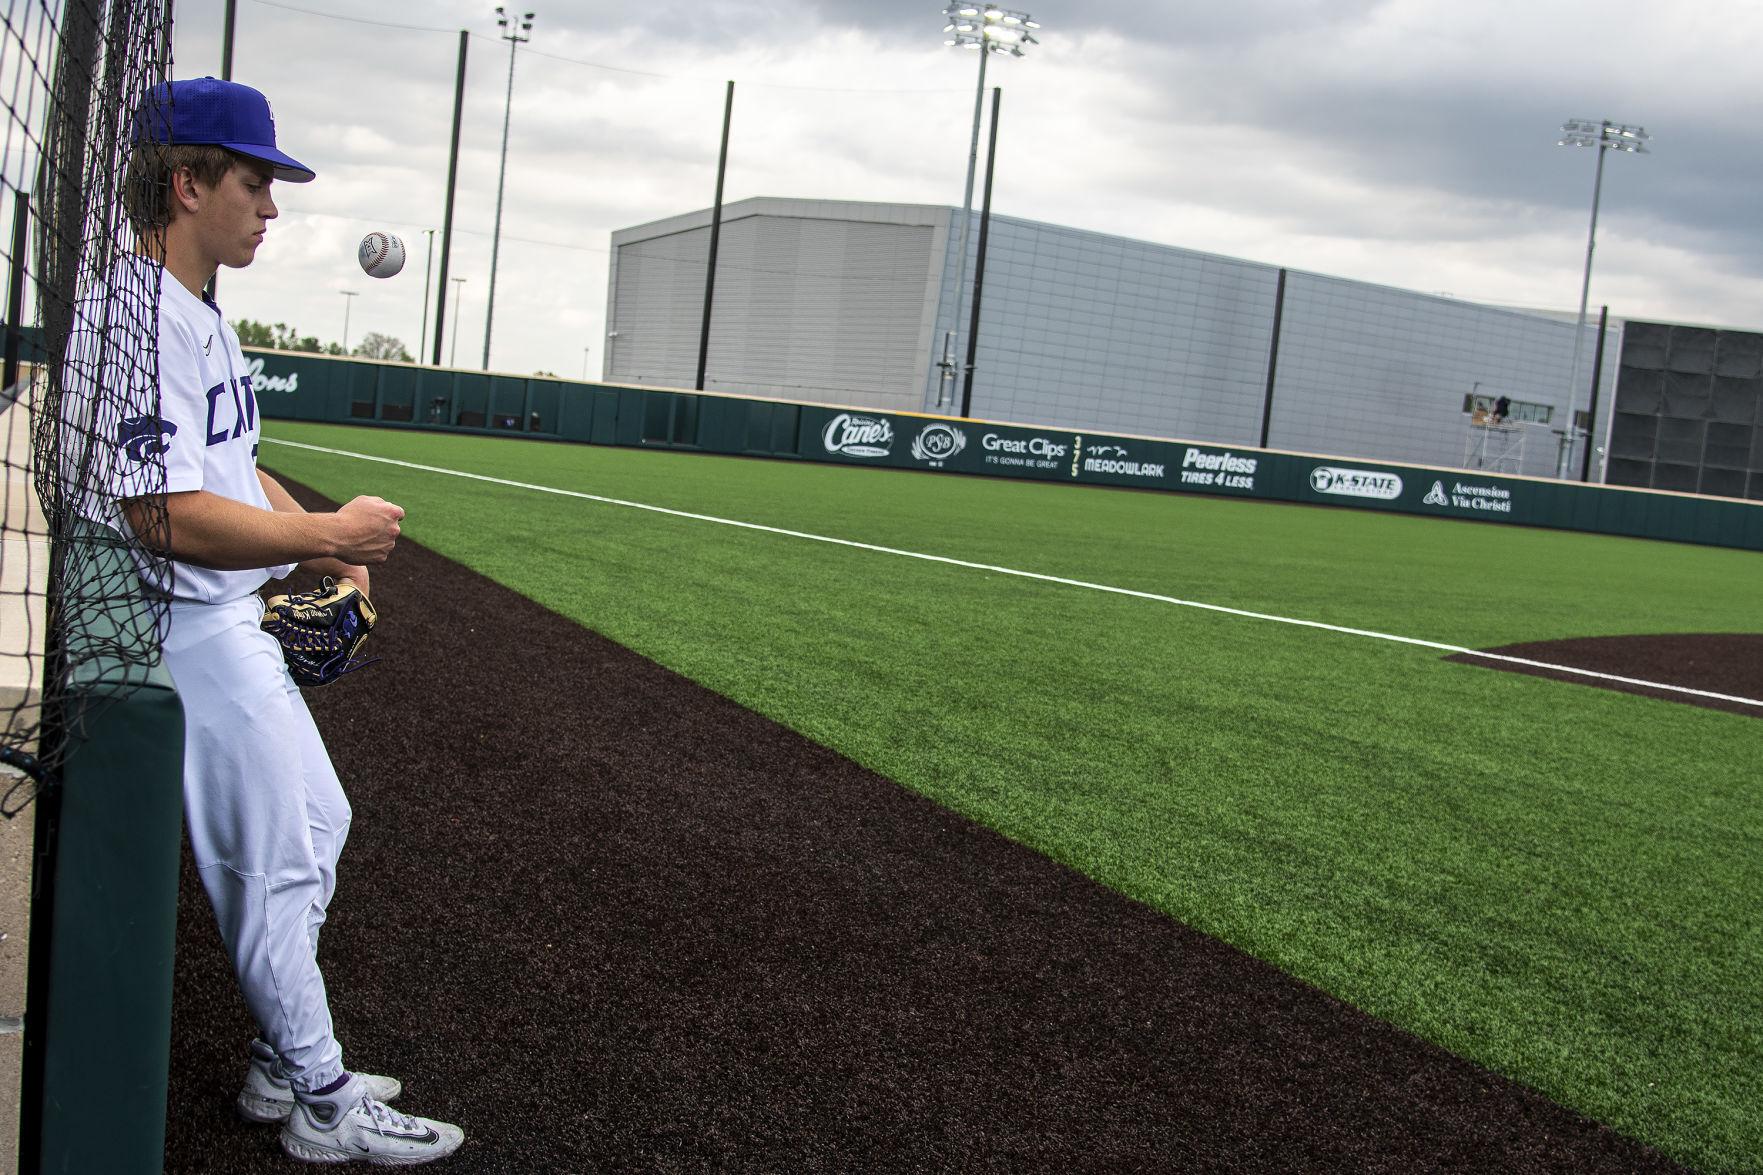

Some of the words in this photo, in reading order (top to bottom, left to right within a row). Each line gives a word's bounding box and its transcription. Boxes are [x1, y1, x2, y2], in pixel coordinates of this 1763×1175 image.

[824, 413, 892, 452] Cane's
[982, 433, 1027, 453] Great
[1028, 438, 1066, 460] Clips
[985, 455, 999, 465] IT'S
[999, 456, 1024, 466] GONNA
[1025, 459, 1035, 468] BE
[1036, 460, 1059, 469] GREAT
[1084, 458, 1165, 477] MEADOWLARK
[1182, 448, 1258, 474] Peerless
[1181, 471, 1214, 485] TIRES
[1214, 472, 1225, 486] 4
[1225, 475, 1254, 489] LESS
[1335, 473, 1396, 491] K-STATE
[1452, 482, 1511, 499] Ascension
[1452, 495, 1471, 508] Via
[1471, 497, 1512, 512] Christi
